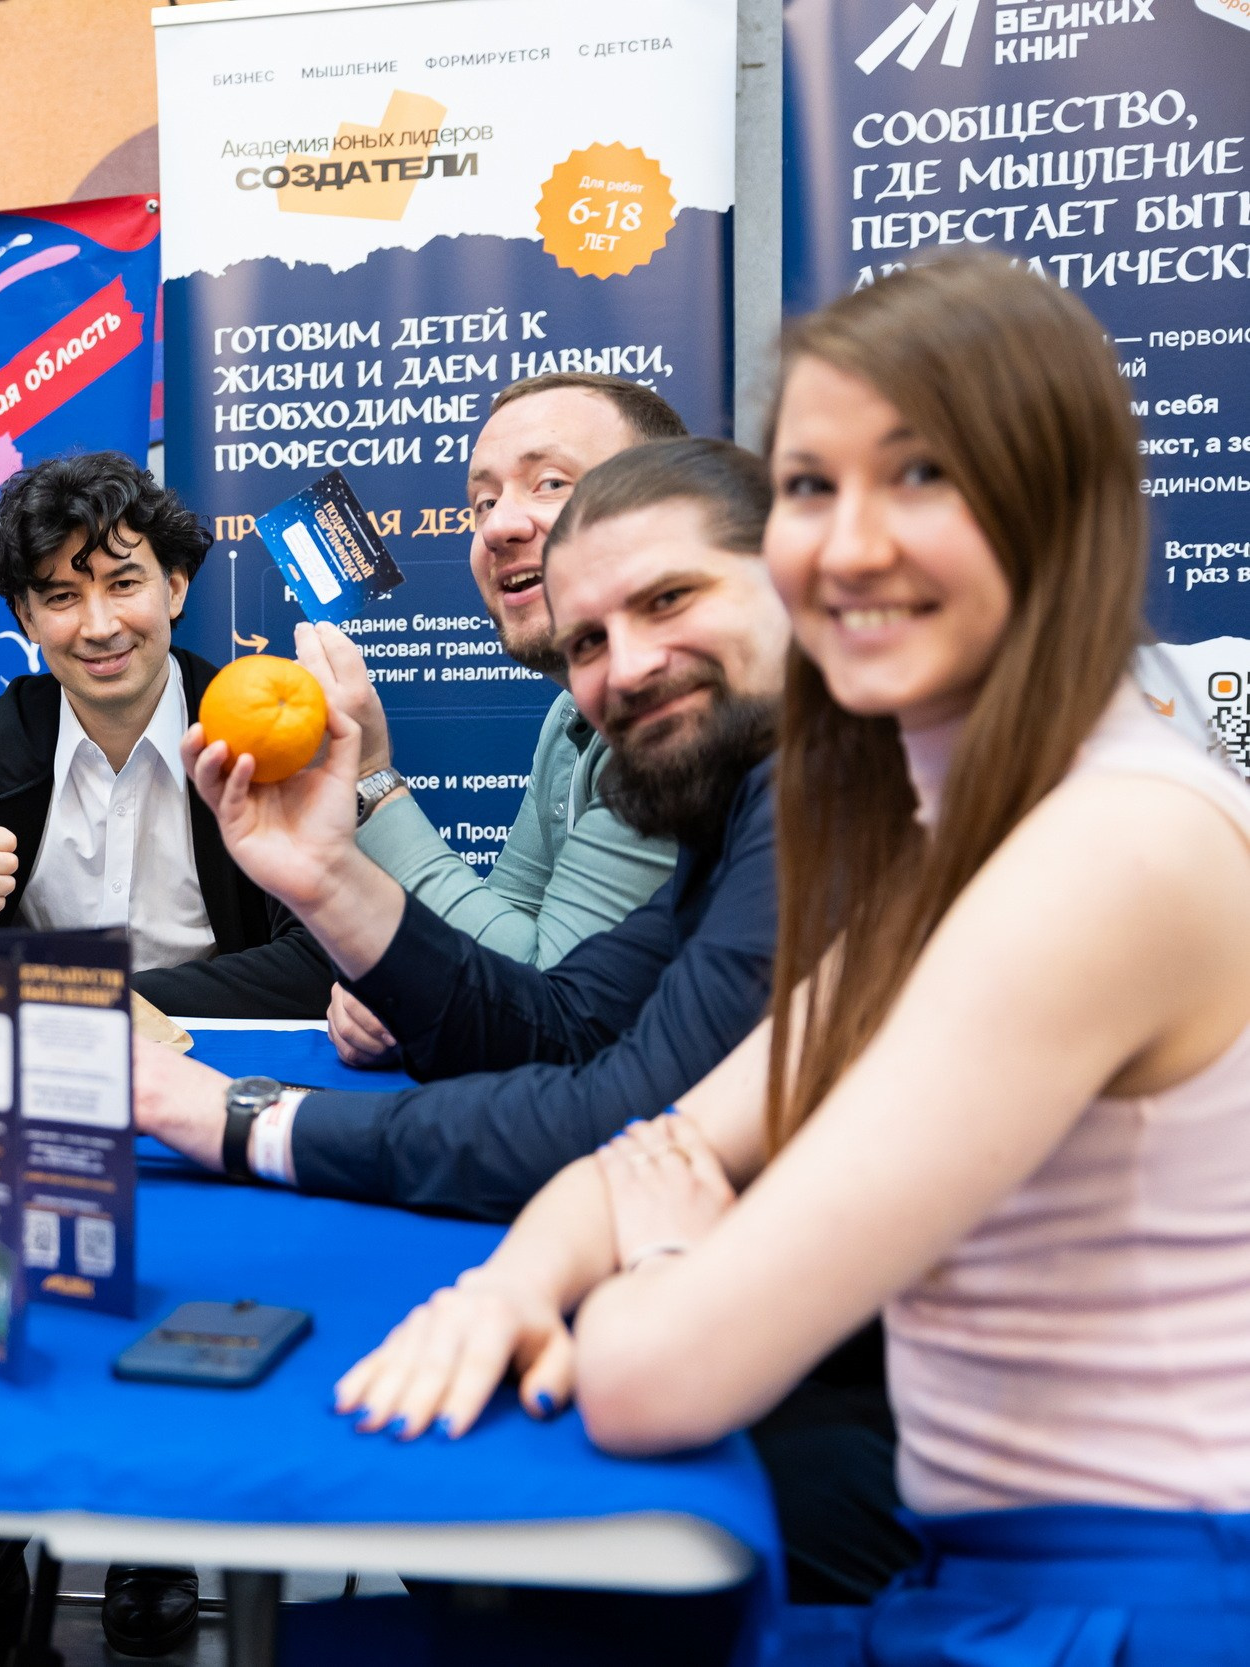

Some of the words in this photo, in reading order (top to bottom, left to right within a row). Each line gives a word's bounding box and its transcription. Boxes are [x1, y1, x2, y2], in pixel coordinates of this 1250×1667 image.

[995, 0, 1155, 35] ВЕЛИКИХ
[213, 70, 275, 87] БИЗНЕС
[301, 60, 399, 79] МЫШЛЕНИЕ
[425, 47, 550, 69] ФОРМИРУЕТСЯ
[578, 44, 590, 56] С
[594, 37, 673, 58] ДЕТСТВА
[995, 32, 1089, 65] КНИГ
[852, 89, 1198, 149] СООБЩЕСТВО,
[221, 137, 329, 160] Академия
[333, 132, 395, 151] юных
[399, 125, 493, 148] лидеров
[235, 152, 478, 192] СОЗДАТЕЛИ
[579, 176, 605, 190] Для
[607, 181, 644, 194] ребят
[853, 159, 942, 204] ГДЕ
[958, 137, 1245, 193] МЫШЛЕНИЕ
[568, 197, 643, 232] 6-18
[851, 199, 1119, 251] ПЕРЕСТАЕТ
[578, 232, 621, 252] ЛЕТ
[214, 320, 381, 355] ГОТОВИМ
[391, 306, 508, 350] ДЕТЕЙ
[520, 310, 547, 340] К
[24, 312, 122, 391] область
[213, 364, 345, 395] ЖИЗНИ
[357, 360, 383, 388] И
[394, 354, 498, 389] ДАЕМ
[511, 345, 673, 381] НАВЫКИ,
[214, 394, 480, 433] НЕОБХОДИМЫЕ
[1155, 394, 1219, 416] себя
[214, 437, 422, 472] ПРОФЕССИИ
[434, 434, 476, 463] 21
[1136, 438, 1199, 458] екст,
[1205, 437, 1221, 454] а
[314, 509, 363, 583] СЕРТИФИКАТ
[323, 500, 375, 579] ПОДАРОЧНЫЙ
[1166, 566, 1176, 584] 1
[1185, 567, 1230, 591] раз
[337, 618, 408, 635] здание
[367, 667, 419, 682] етинг
[424, 668, 436, 682] и
[400, 775, 440, 790] кое
[445, 775, 457, 789] и
